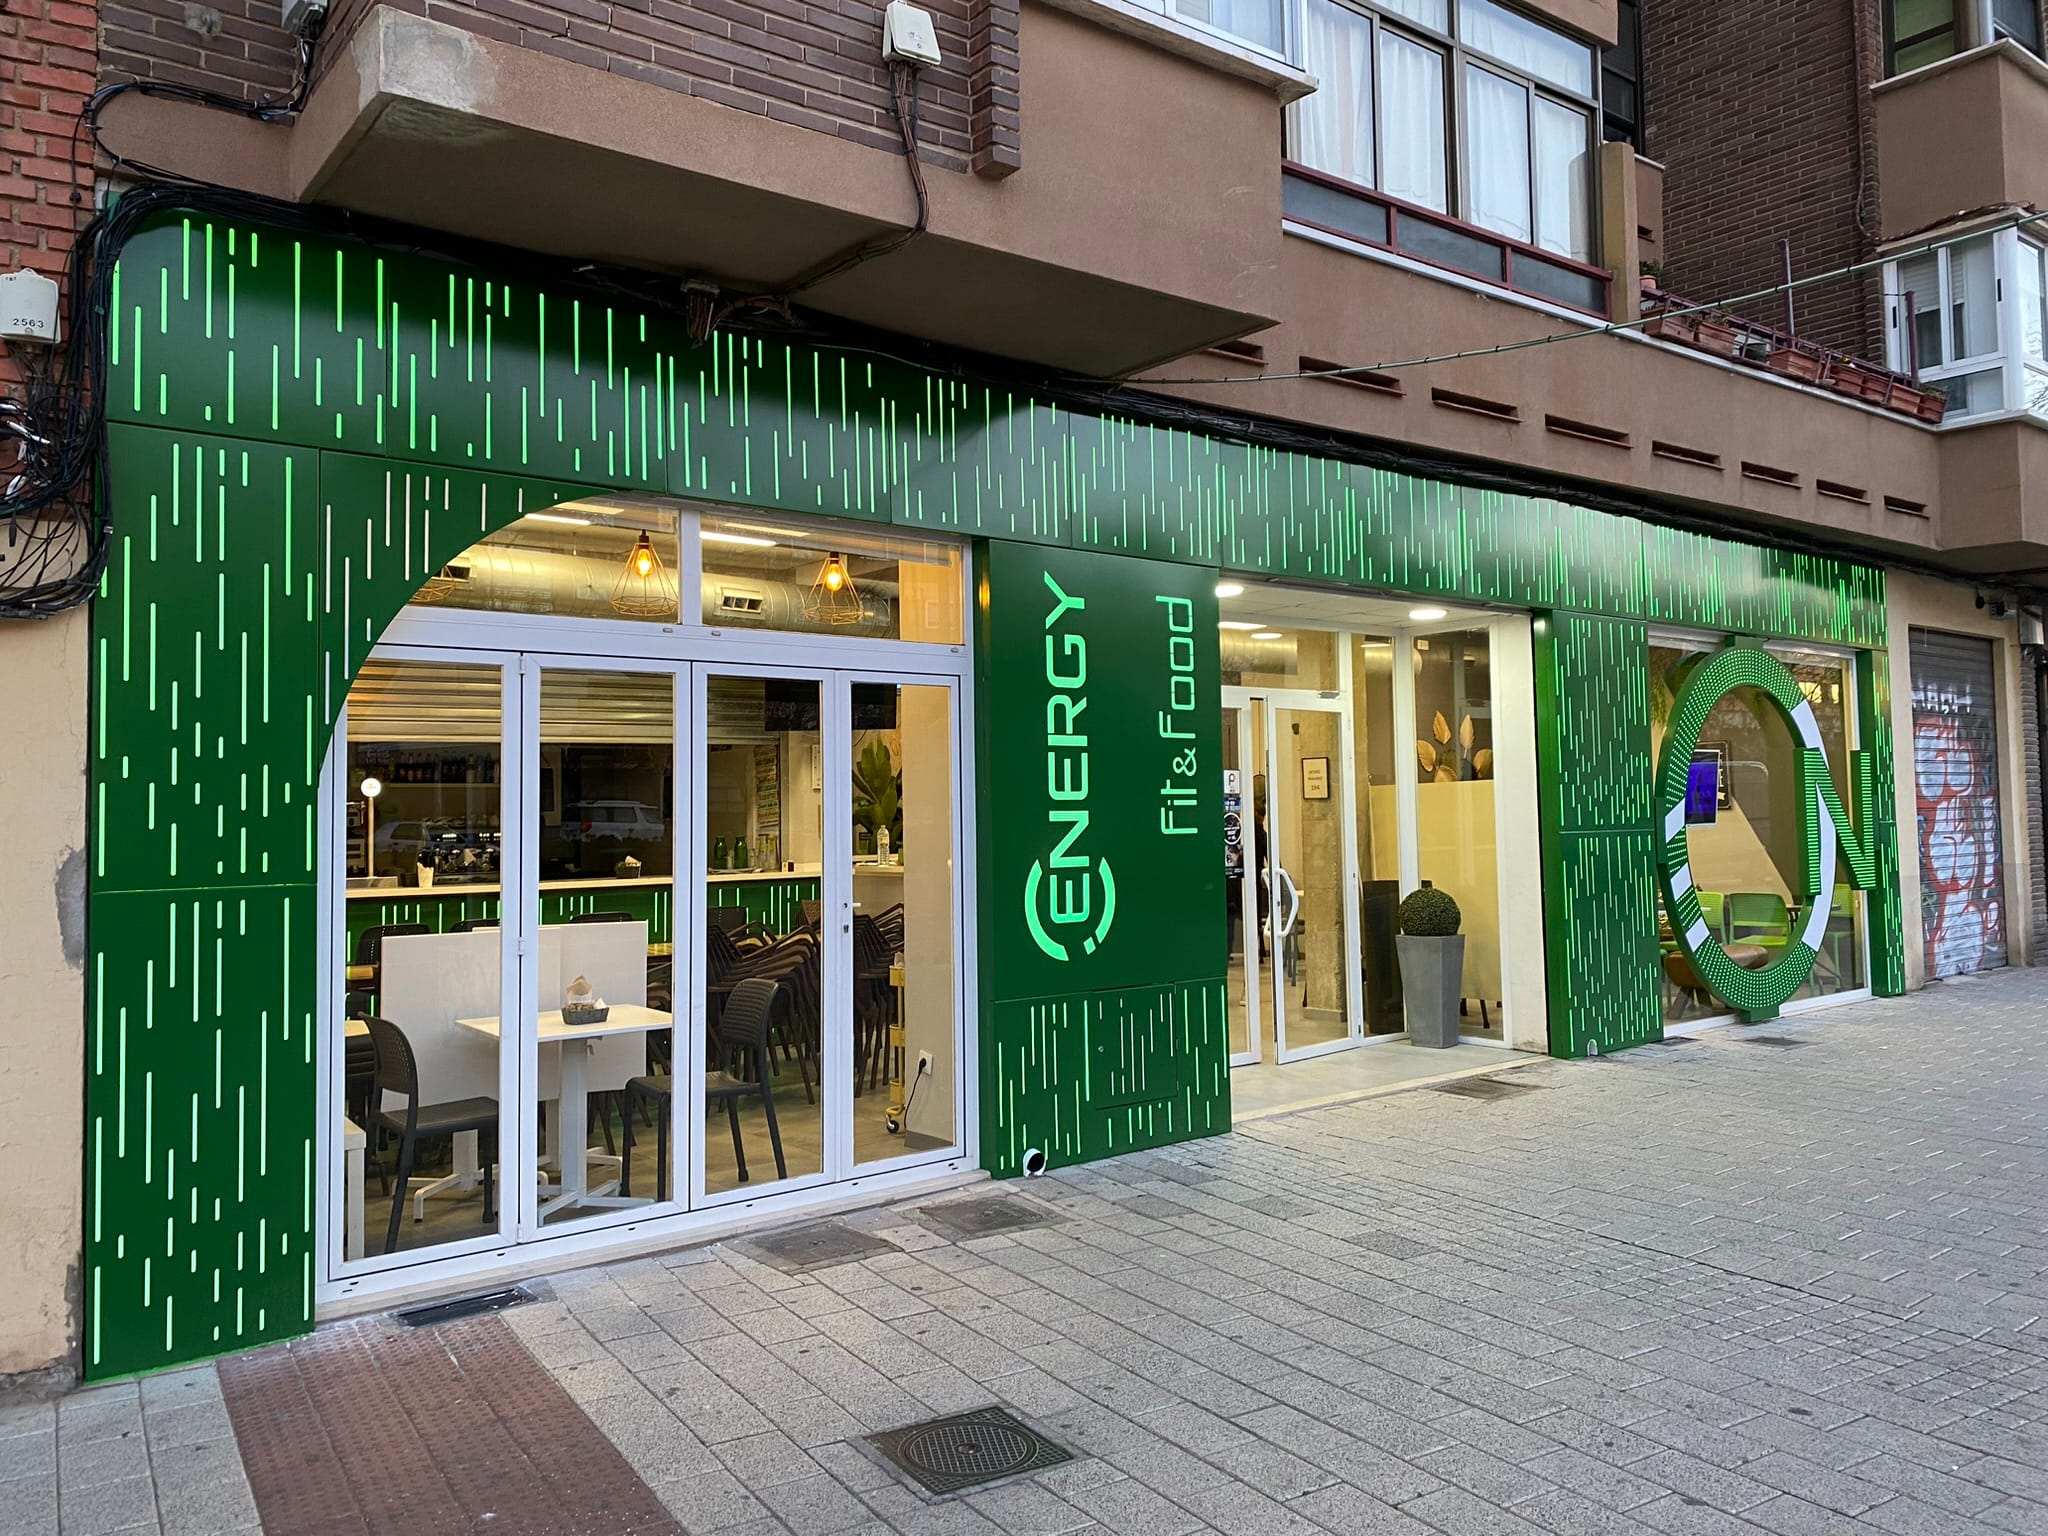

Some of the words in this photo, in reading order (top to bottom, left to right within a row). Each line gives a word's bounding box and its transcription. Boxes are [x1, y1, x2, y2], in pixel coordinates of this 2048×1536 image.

[12, 318, 45, 329] 2563
[1043, 570, 1091, 925] ENERGY
[1656, 636, 1877, 1020] ON
